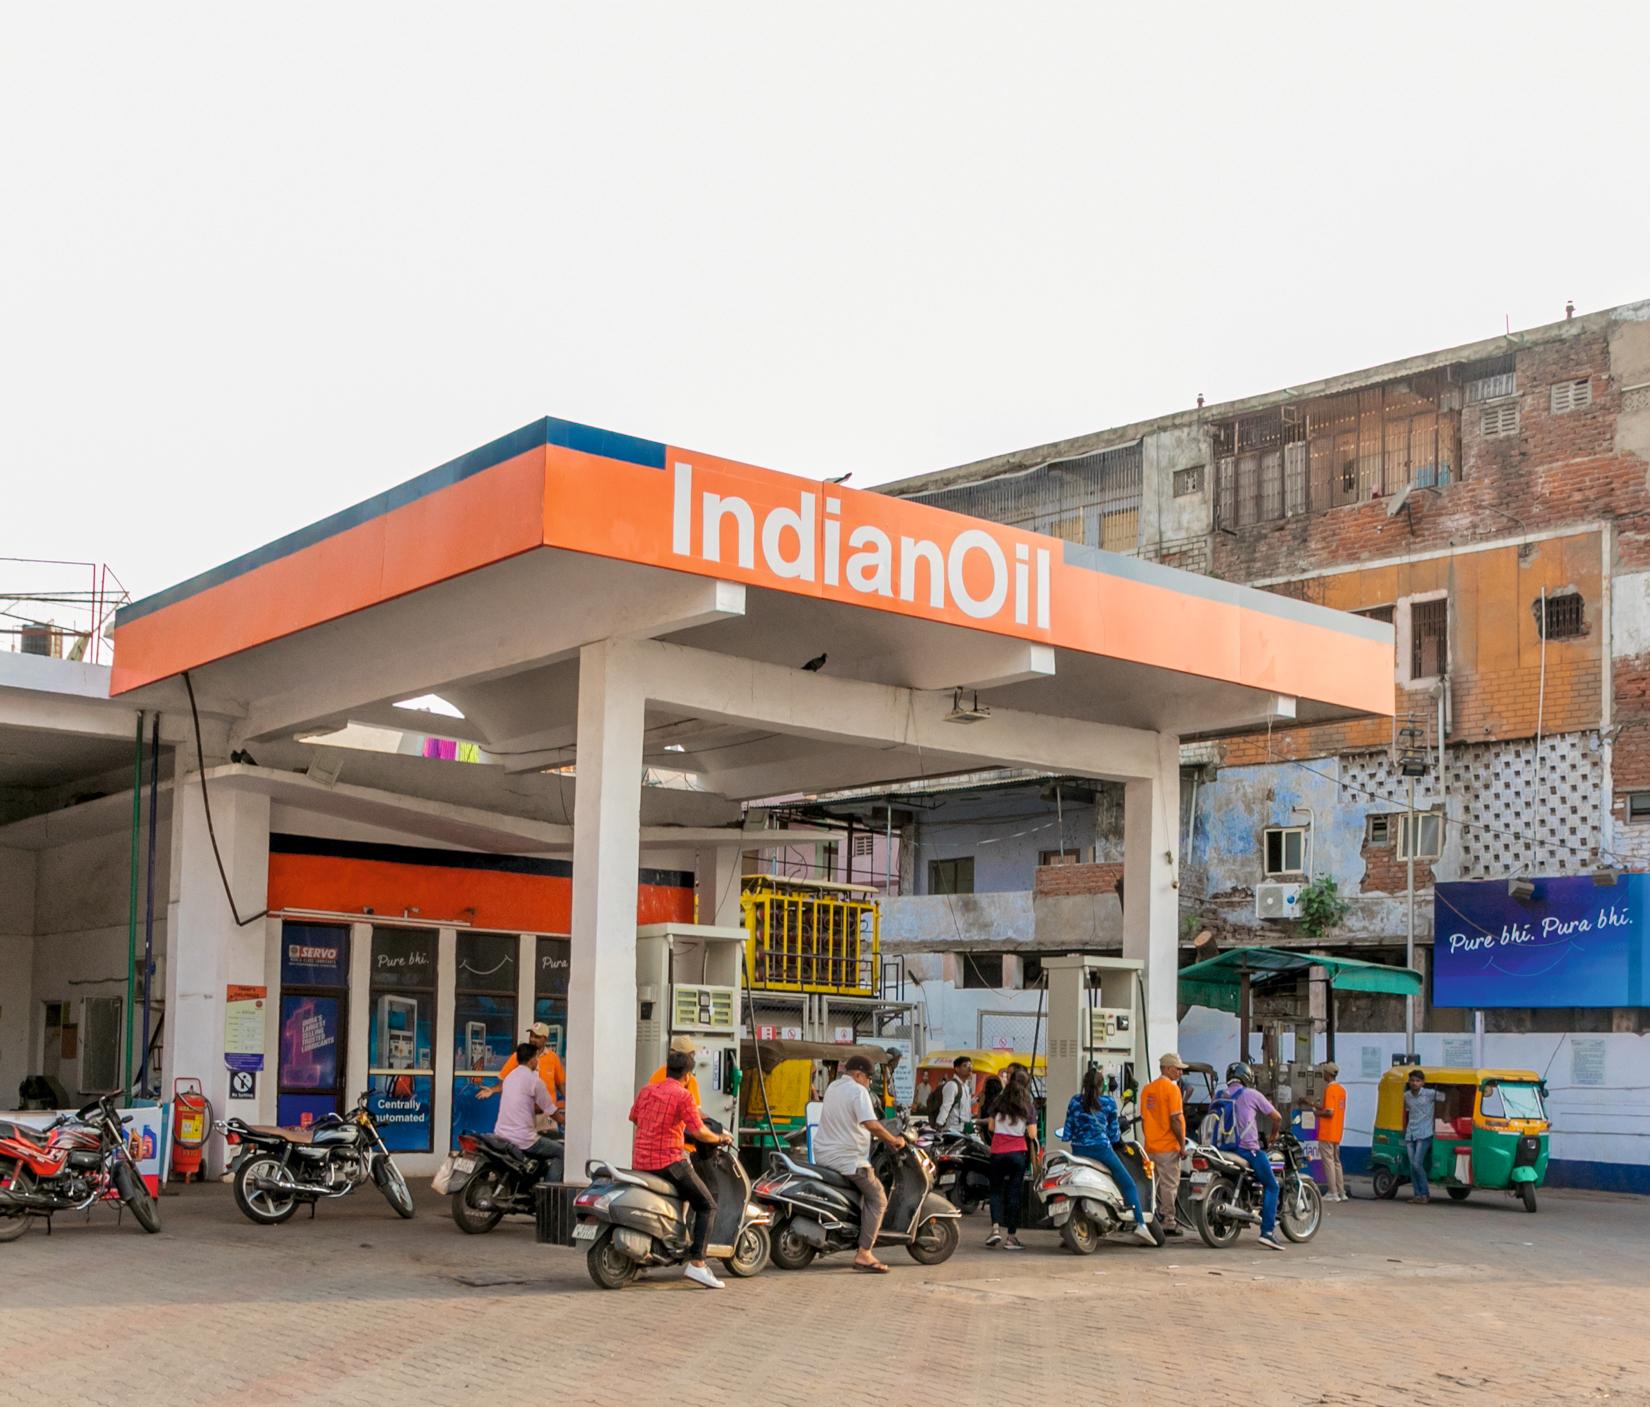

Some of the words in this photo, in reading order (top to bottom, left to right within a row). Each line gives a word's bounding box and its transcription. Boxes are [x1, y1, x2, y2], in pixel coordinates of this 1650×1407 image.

[672, 462, 1050, 629] IndianOil
[1450, 933, 1495, 954] Pure
[1500, 923, 1535, 946] bhi.
[1541, 917, 1592, 938] Pura
[1597, 906, 1633, 929] bhi.
[300, 947, 337, 959] SERVO
[377, 954, 406, 968] Pure
[408, 951, 430, 965] bhi.
[542, 956, 569, 970] Pura
[377, 1099, 421, 1111] Centrally
